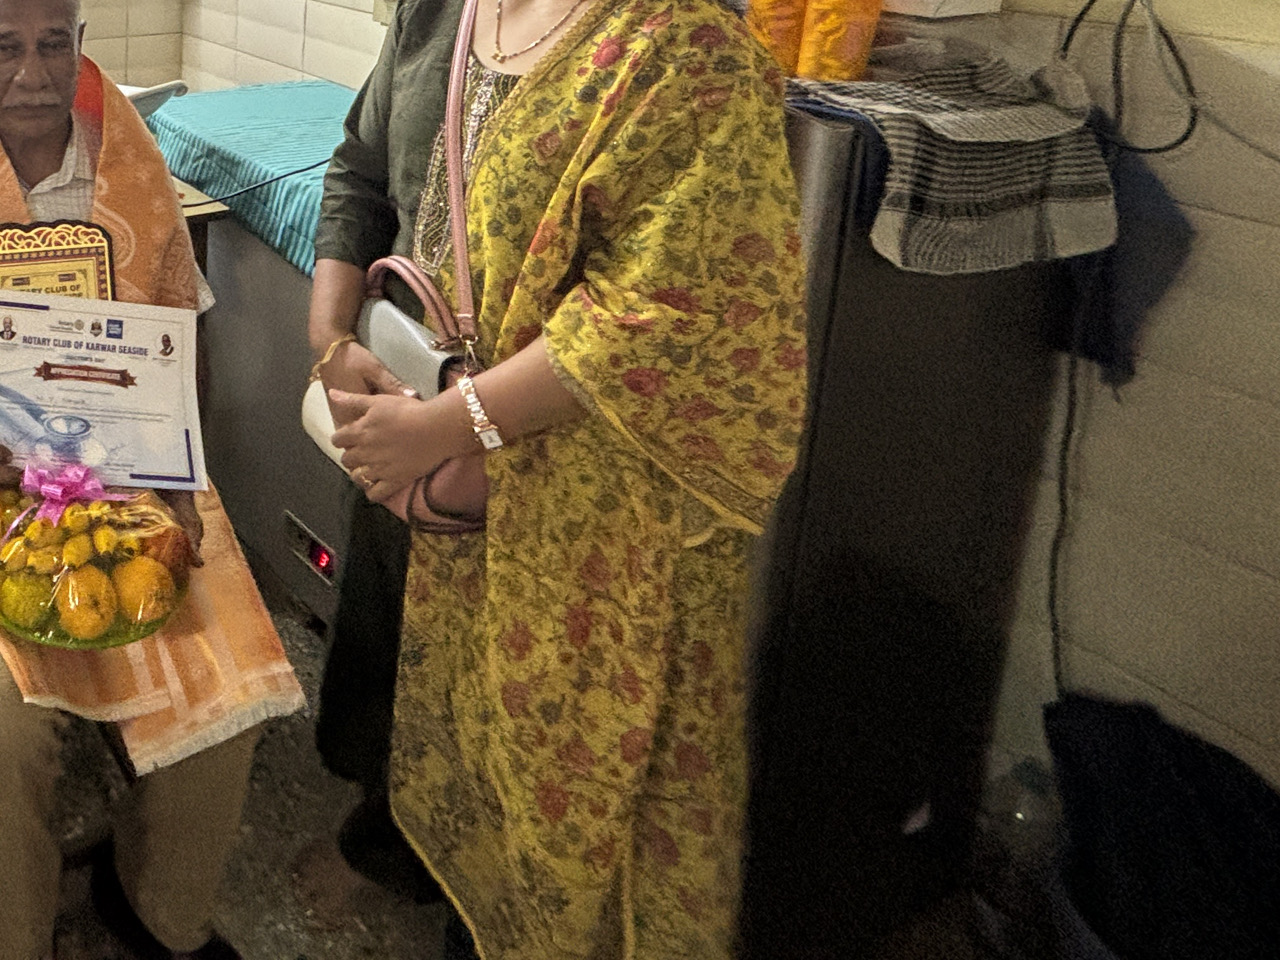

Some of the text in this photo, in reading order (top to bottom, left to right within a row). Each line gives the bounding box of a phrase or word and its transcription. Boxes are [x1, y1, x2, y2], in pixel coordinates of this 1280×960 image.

[44, 285, 68, 294] CLUB
[70, 283, 81, 292] OF
[22, 335, 51, 347] ROTARY
[53, 338, 72, 349] CLUB
[74, 340, 84, 350] OF
[85, 341, 117, 353] KARWAR
[118, 345, 149, 356] SEASIDE
